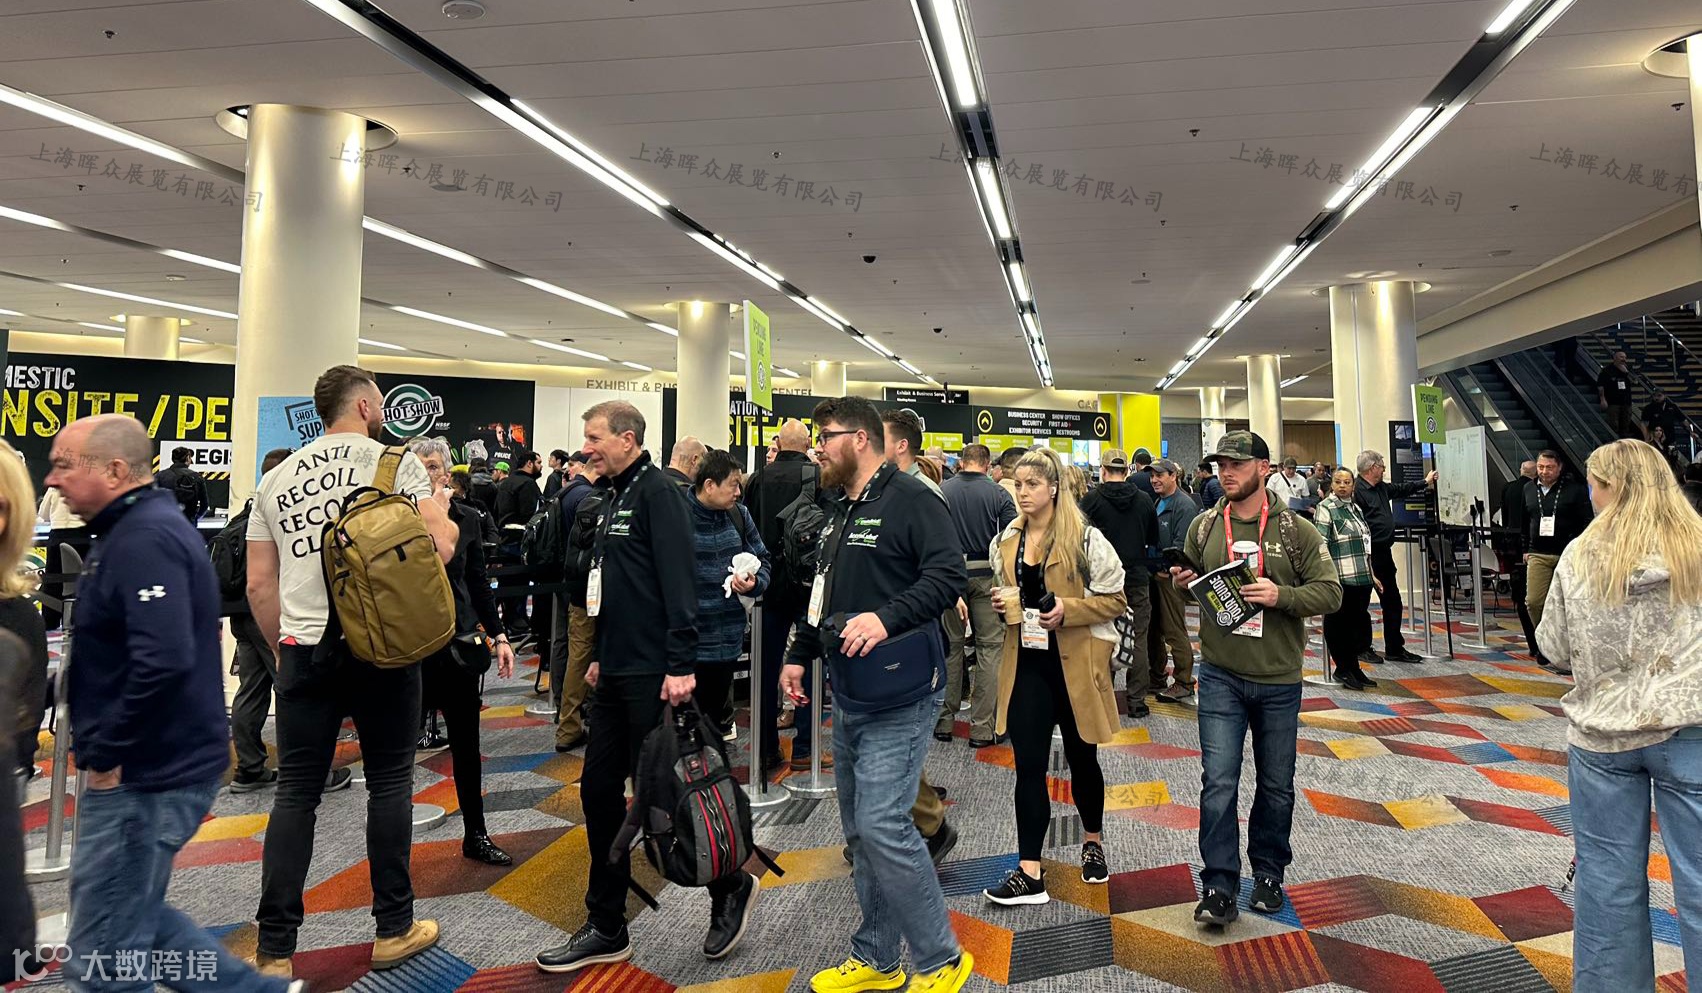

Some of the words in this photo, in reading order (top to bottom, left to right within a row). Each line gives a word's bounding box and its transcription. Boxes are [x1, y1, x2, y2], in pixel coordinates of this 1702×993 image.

[1420, 393, 1438, 404] PENDING
[1425, 404, 1436, 414] LINE
[295, 410, 315, 421] SHOT
[297, 421, 325, 440] SUP
[294, 445, 352, 477] ANTI
[494, 451, 511, 460] POLICE
[275, 467, 359, 513] RECOIL
[278, 496, 348, 535] RECO
[291, 535, 323, 559] CL
[1208, 574, 1232, 602] GUIDE
[1223, 597, 1246, 624] YOUR
